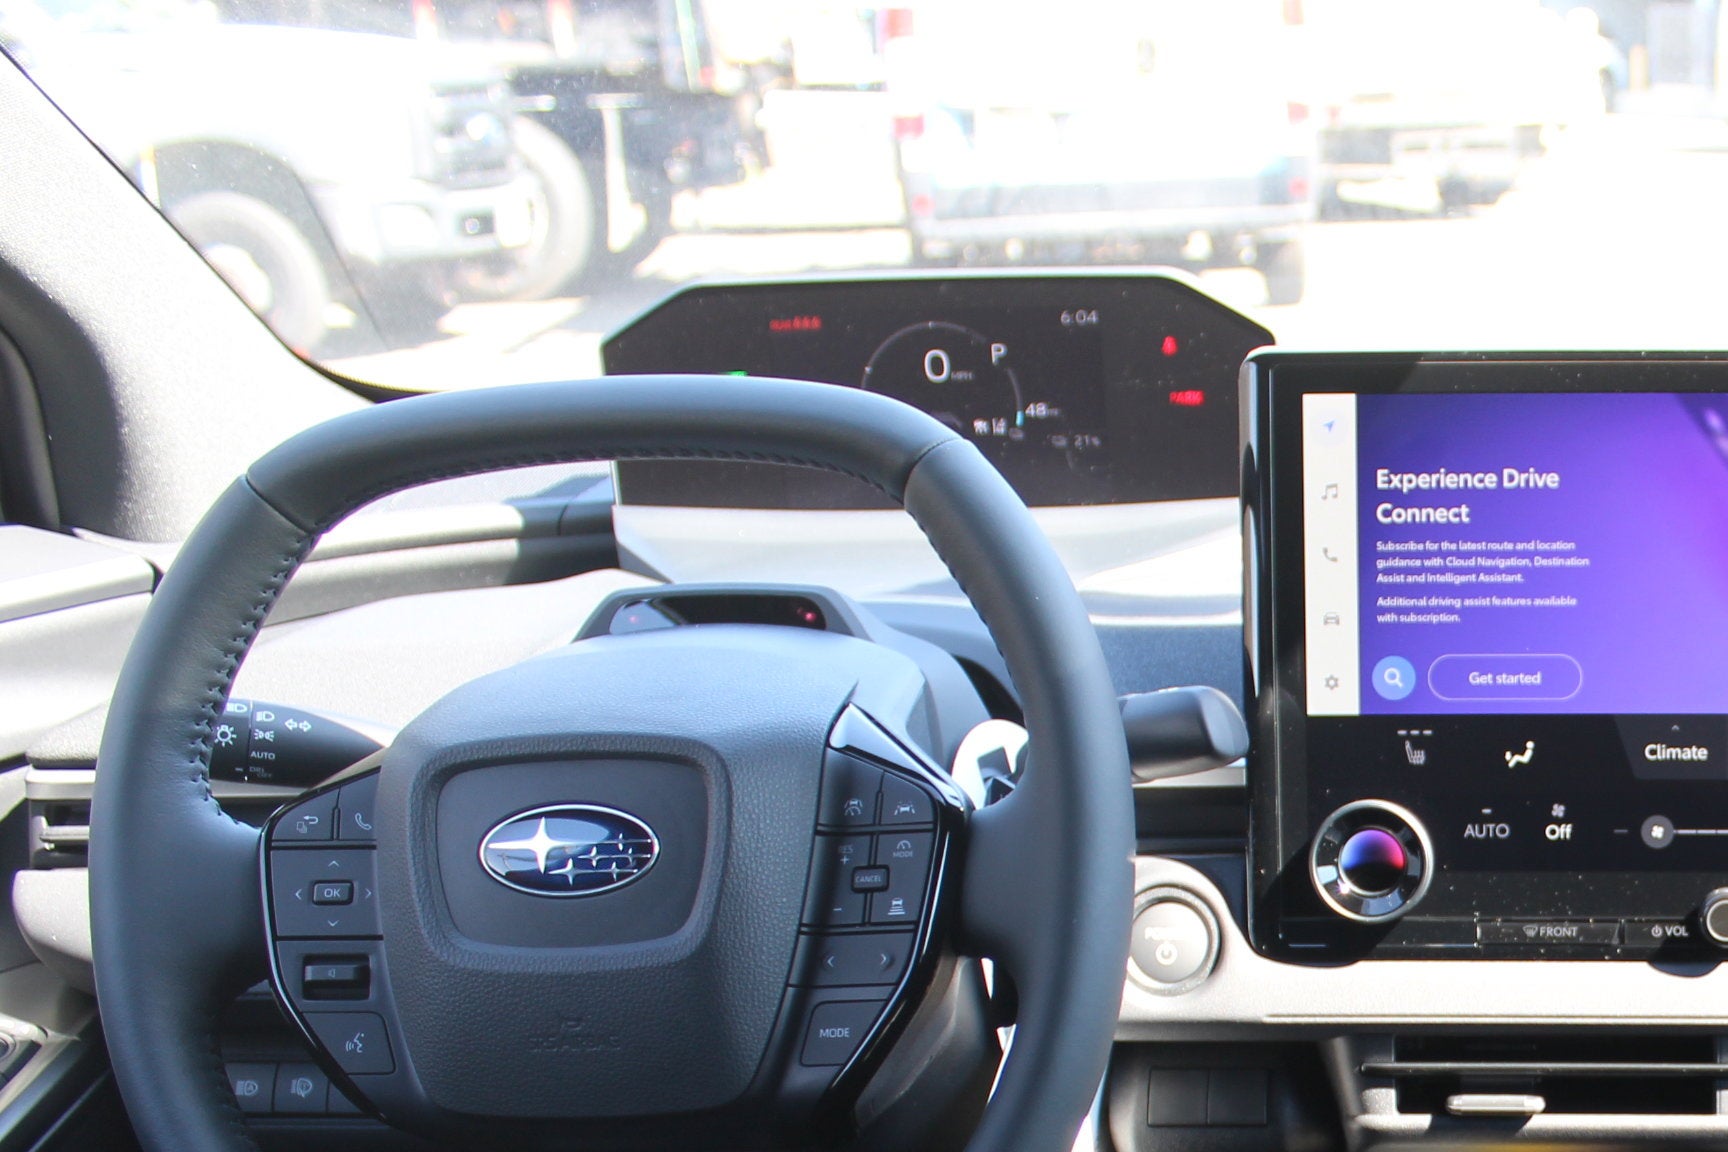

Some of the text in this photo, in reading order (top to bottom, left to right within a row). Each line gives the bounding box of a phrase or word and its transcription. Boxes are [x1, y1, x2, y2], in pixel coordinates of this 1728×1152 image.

[1060, 309, 1099, 326] 6:04
[990, 343, 1008, 366] P
[924, 349, 950, 383] 0
[1376, 467, 1560, 494] Experience Drive
[1376, 503, 1470, 524] Connect
[1376, 540, 1576, 552] Subscribe for the latest route and location
[1376, 556, 1590, 569] guidance with Cloud Navigation, Destination
[1376, 572, 1525, 585] Assist and Intelligent Assistant.
[1376, 596, 1577, 609] Additional driving assist features available
[1376, 613, 1461, 625] with subscription.
[1468, 670, 1542, 686] Get started
[250, 751, 276, 760] AUTO
[1644, 743, 1709, 761] Climate
[1463, 823, 1573, 840] AUTO Off
[855, 875, 882, 883] CANCEL
[324, 888, 341, 898] OK
[1539, 926, 1579, 938] FRONT
[1664, 925, 1689, 937] VOL
[819, 1027, 850, 1038] MODE
